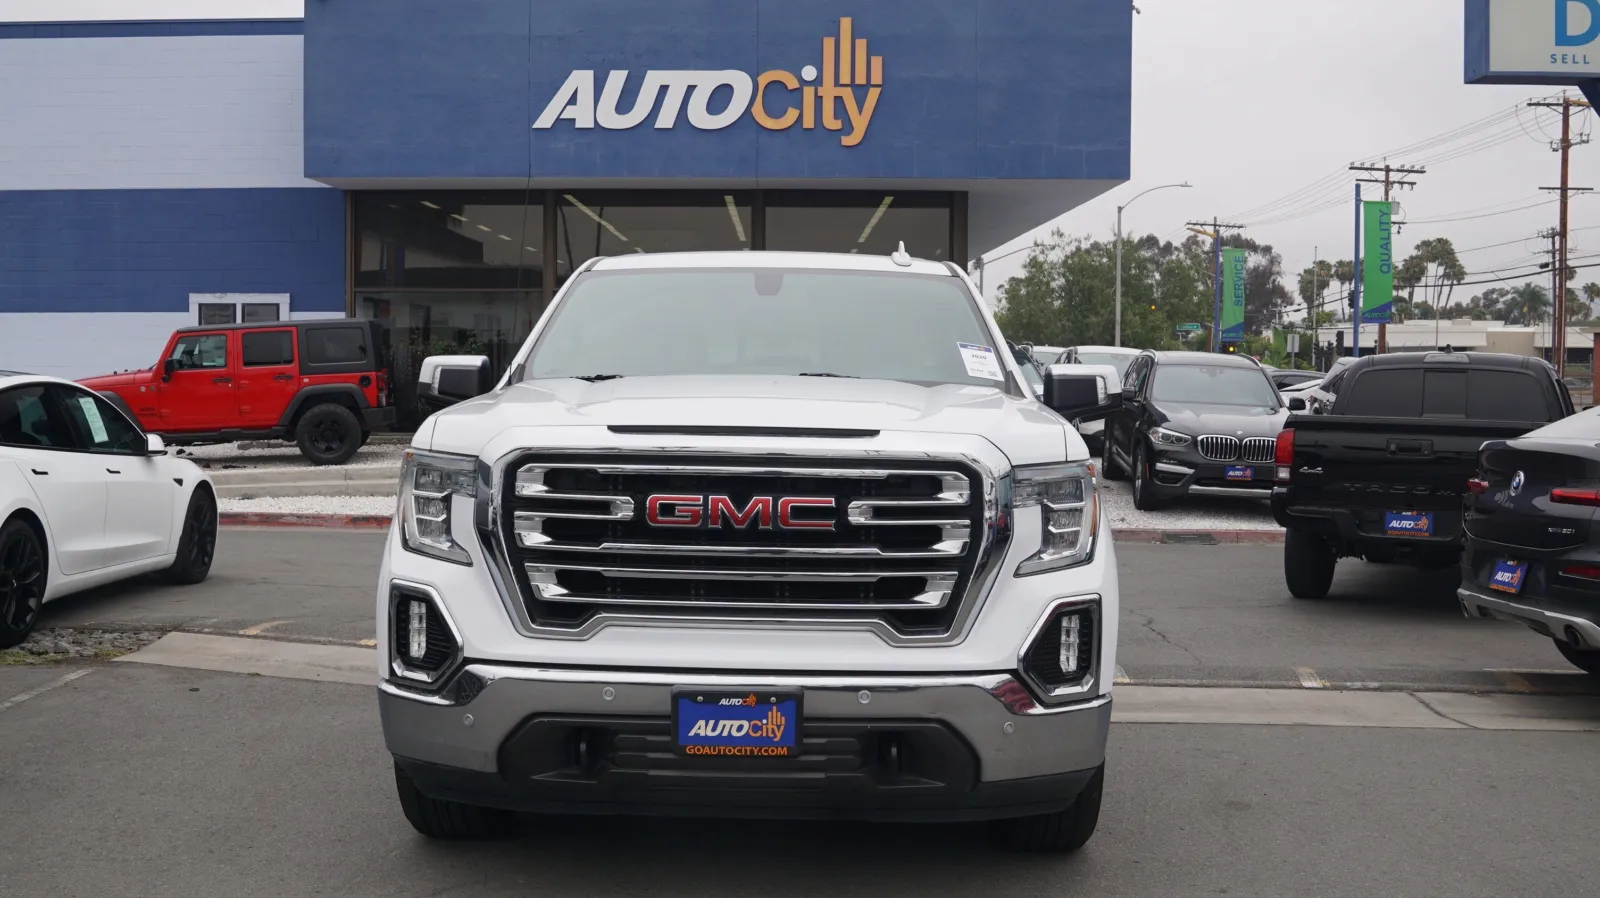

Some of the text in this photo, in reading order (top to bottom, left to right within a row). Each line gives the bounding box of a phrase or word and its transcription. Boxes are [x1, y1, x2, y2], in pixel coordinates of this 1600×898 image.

[1550, 53, 1590, 64] SELL
[646, 494, 836, 530] GMC
[719, 693, 757, 708] AUTOCity
[688, 708, 785, 742] AUTOCity
[686, 746, 788, 756] GOAUTOCITY.COM
